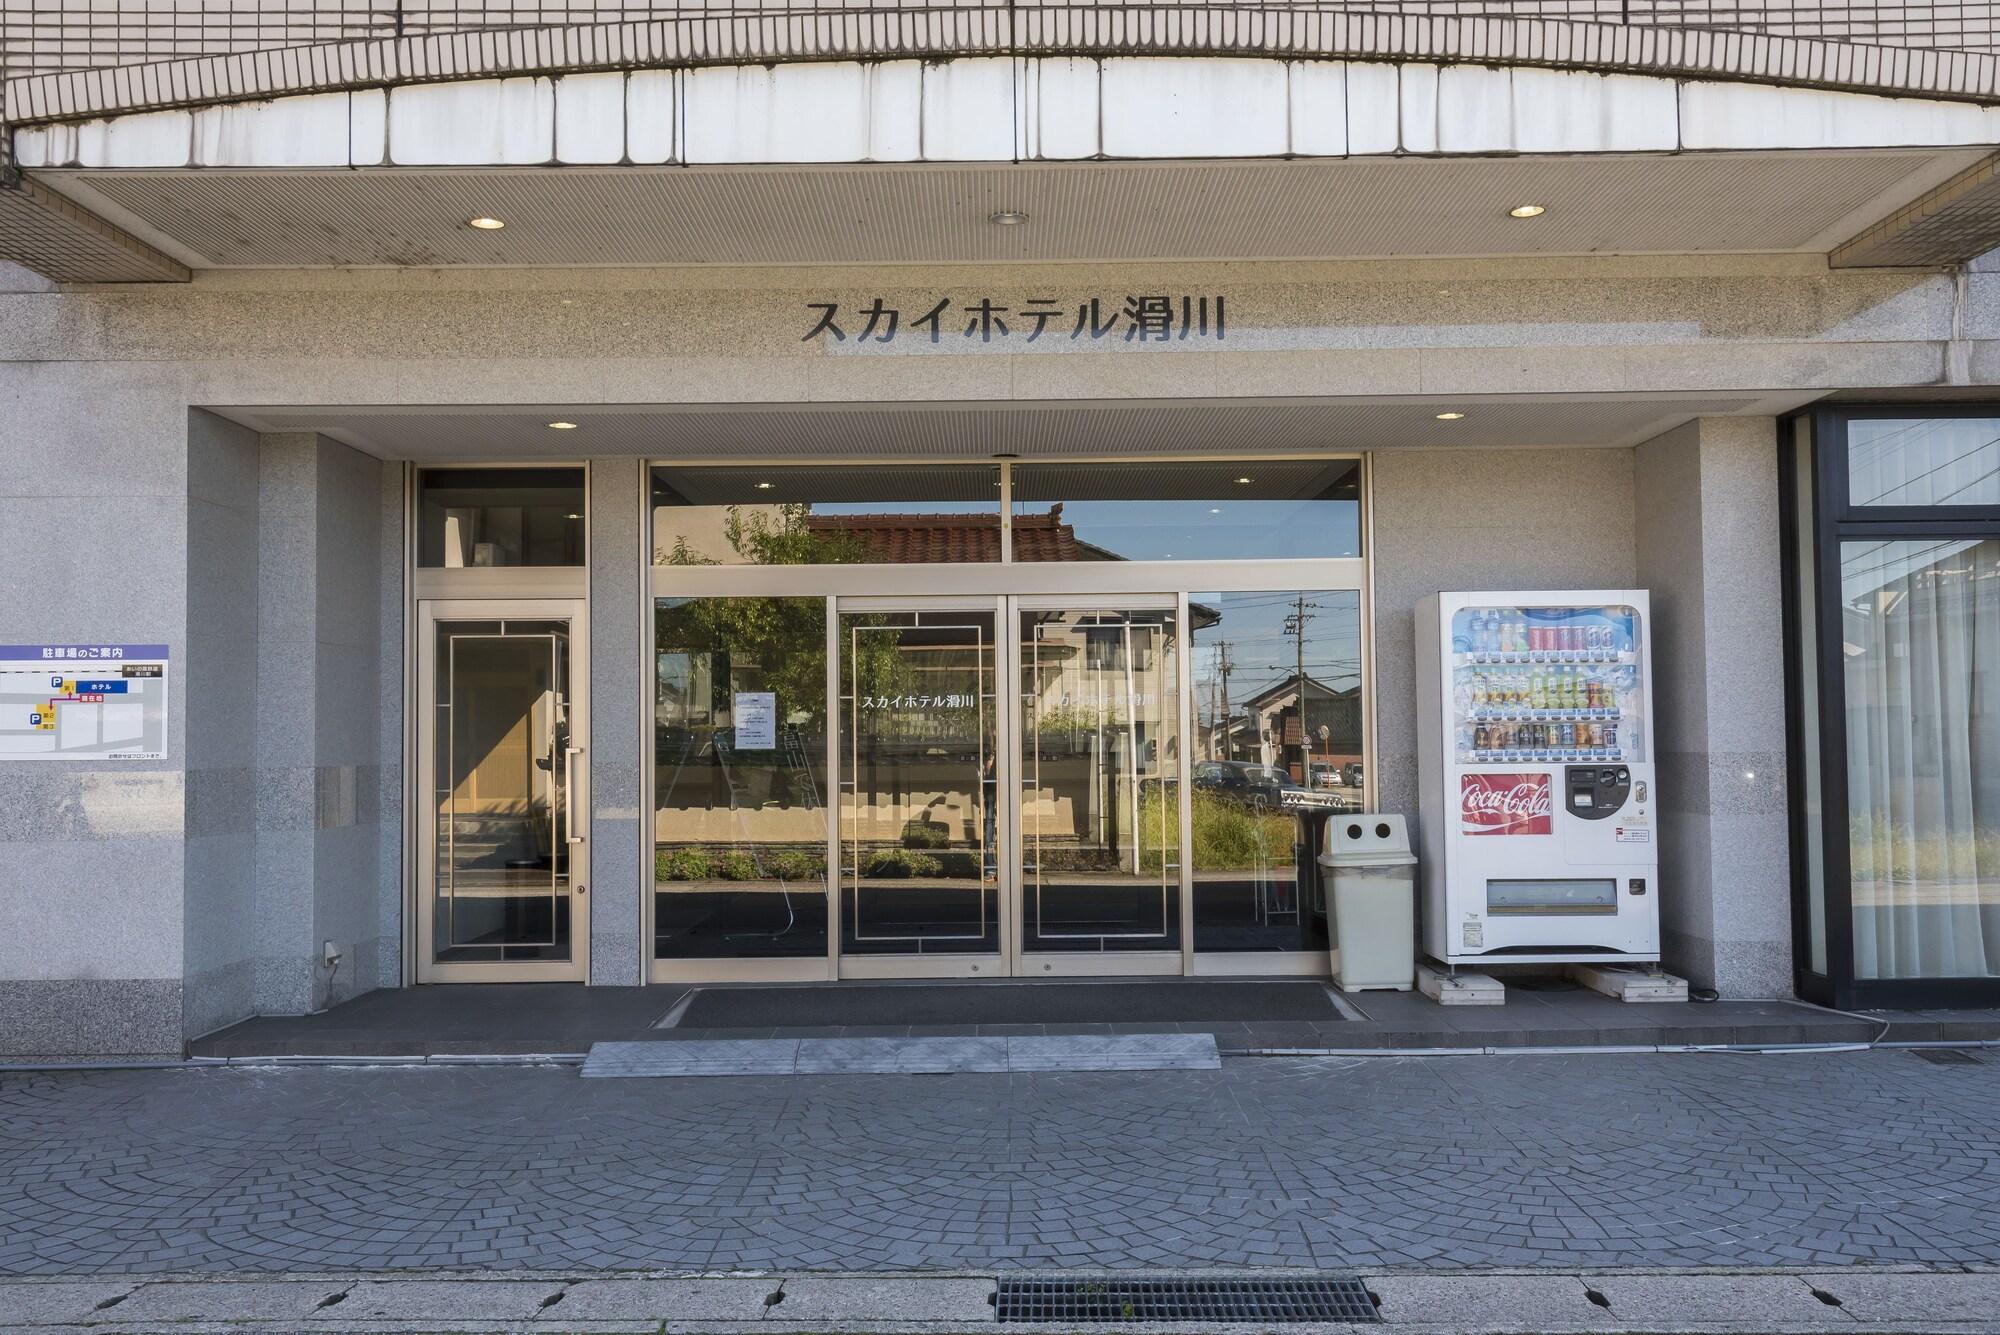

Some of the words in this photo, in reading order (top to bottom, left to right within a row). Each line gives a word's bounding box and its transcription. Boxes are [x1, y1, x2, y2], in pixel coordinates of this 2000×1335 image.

[801, 295, 1225, 343] スカイホテル滑川
[42, 647, 123, 658] 駐車場のご案内
[862, 694, 974, 709] スカイホテル滑川
[1461, 783, 1552, 815] Coca-Cola
